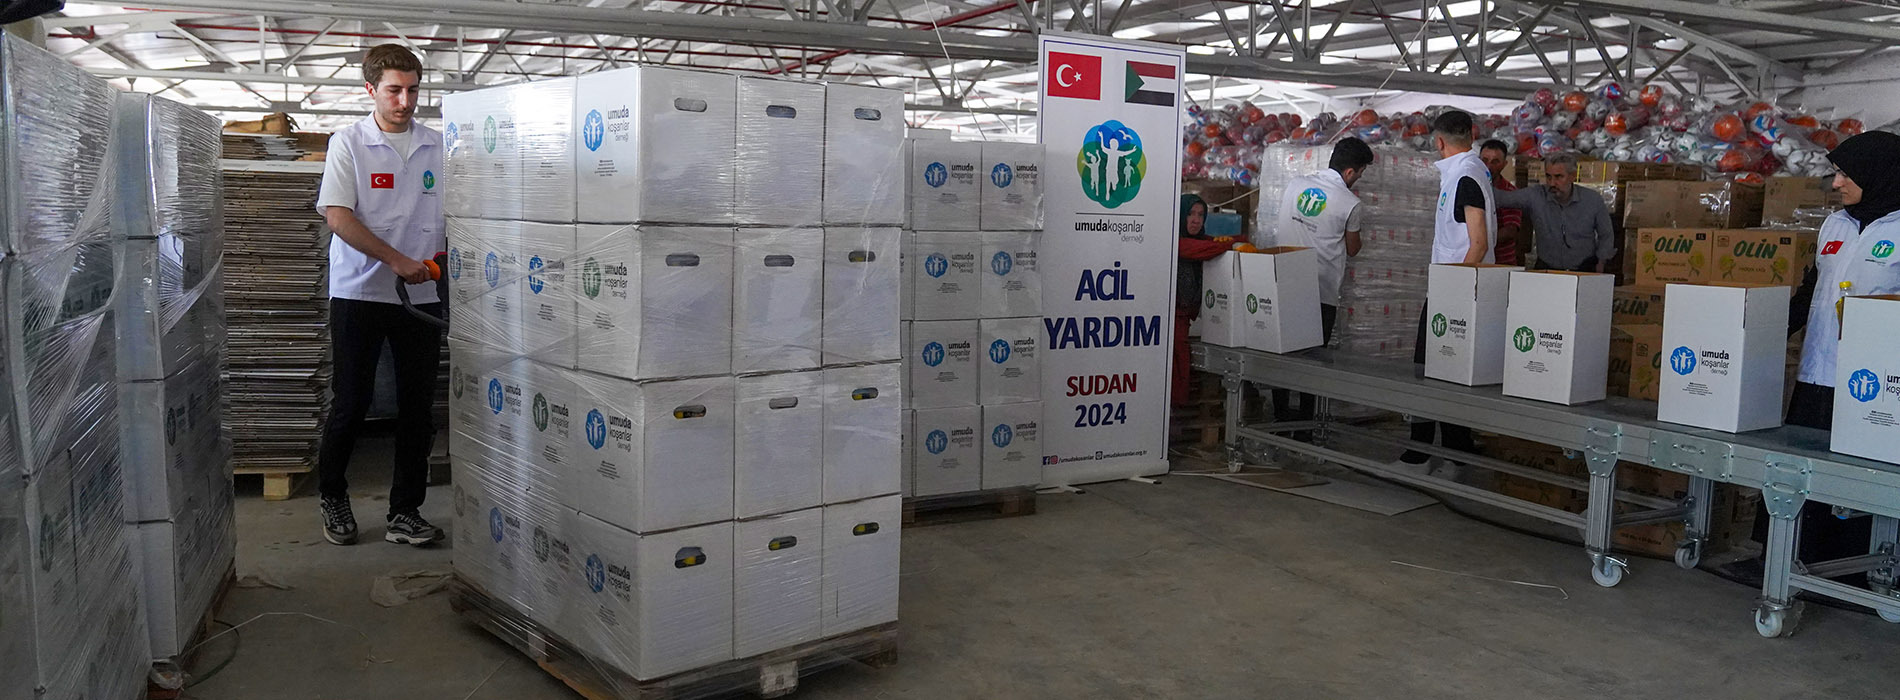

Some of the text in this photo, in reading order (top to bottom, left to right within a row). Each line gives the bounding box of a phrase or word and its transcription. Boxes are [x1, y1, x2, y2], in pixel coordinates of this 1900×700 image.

[607, 105, 630, 120] umuda
[952, 163, 974, 171] umuda
[1016, 163, 1037, 171] umuda
[1075, 219, 1144, 235] umudakoşanlar
[1075, 261, 1135, 301] ACİL
[1450, 319, 1467, 327] umuda
[1043, 315, 1161, 350] YARDIM
[1540, 332, 1563, 341] umuda
[948, 341, 970, 349] umuda
[1014, 337, 1034, 346] umuda
[1539, 339, 1563, 349] koşanlar
[1701, 350, 1729, 360] umuda
[1701, 358, 1730, 369] koşanlar
[1066, 373, 1137, 397] SUDAN
[551, 404, 569, 417] umuda
[1075, 402, 1127, 428] 2024
[609, 414, 632, 430] umuda
[609, 428, 632, 442] koşanlar
[951, 427, 973, 436] umuda
[608, 563, 631, 580] umuda
